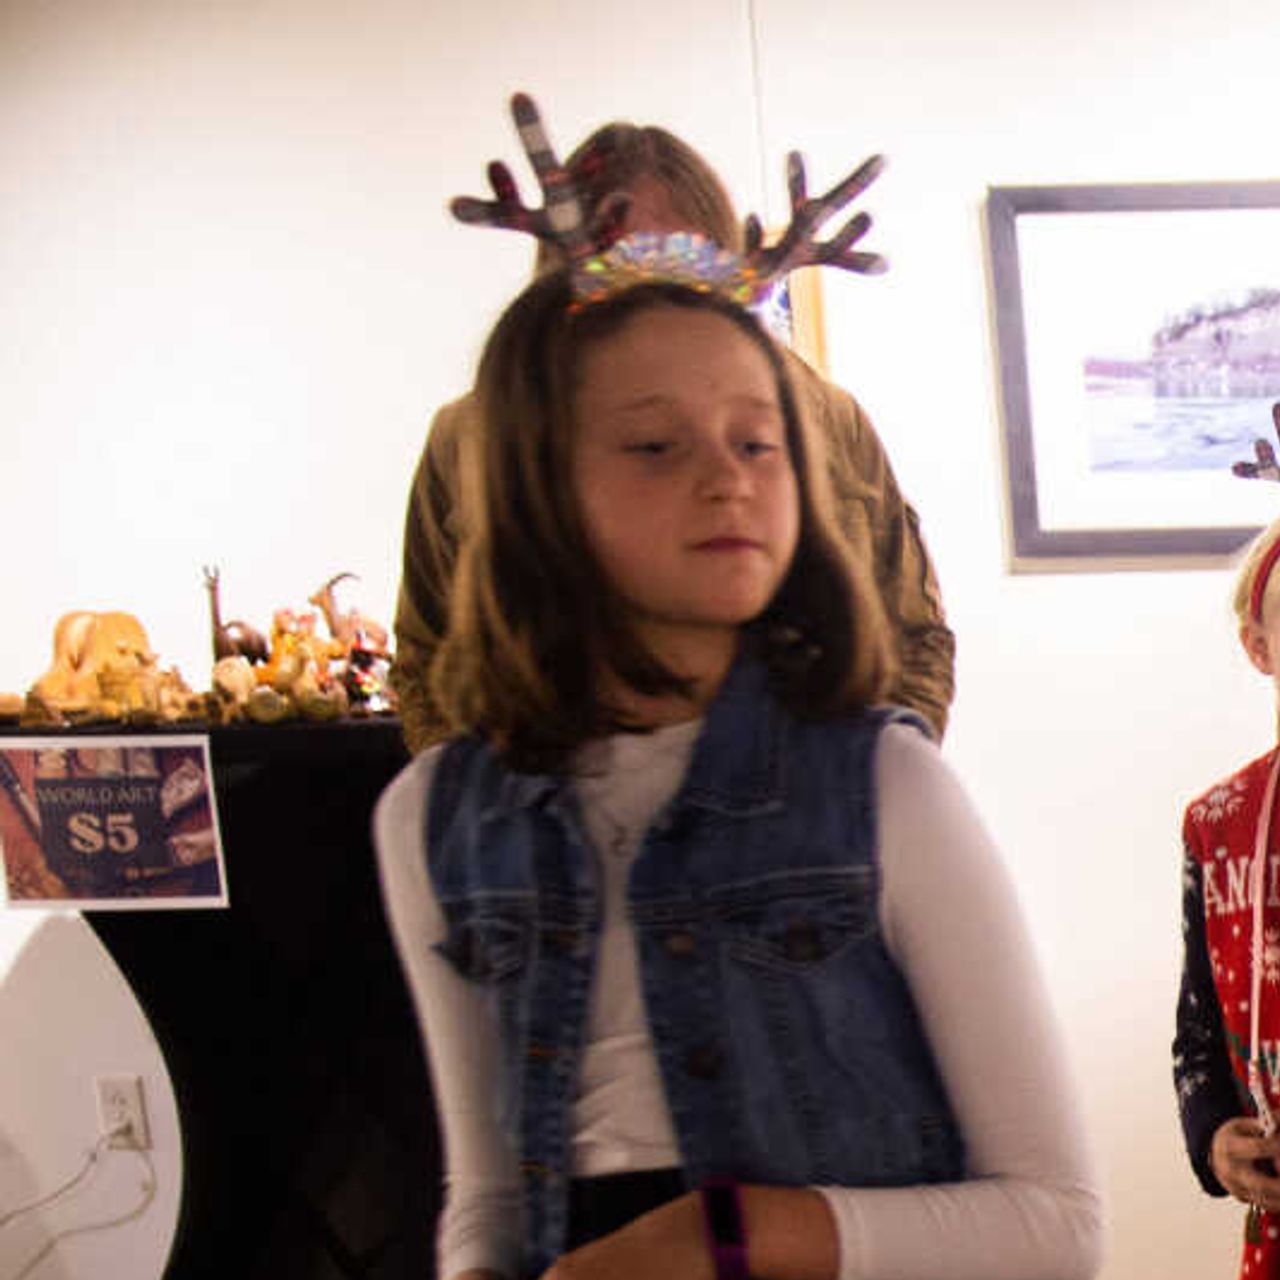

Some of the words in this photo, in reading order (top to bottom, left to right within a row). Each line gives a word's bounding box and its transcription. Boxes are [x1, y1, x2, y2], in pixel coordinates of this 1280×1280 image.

[39, 786, 111, 802] WORLD
[118, 786, 155, 801] ART
[68, 813, 138, 853] $5
